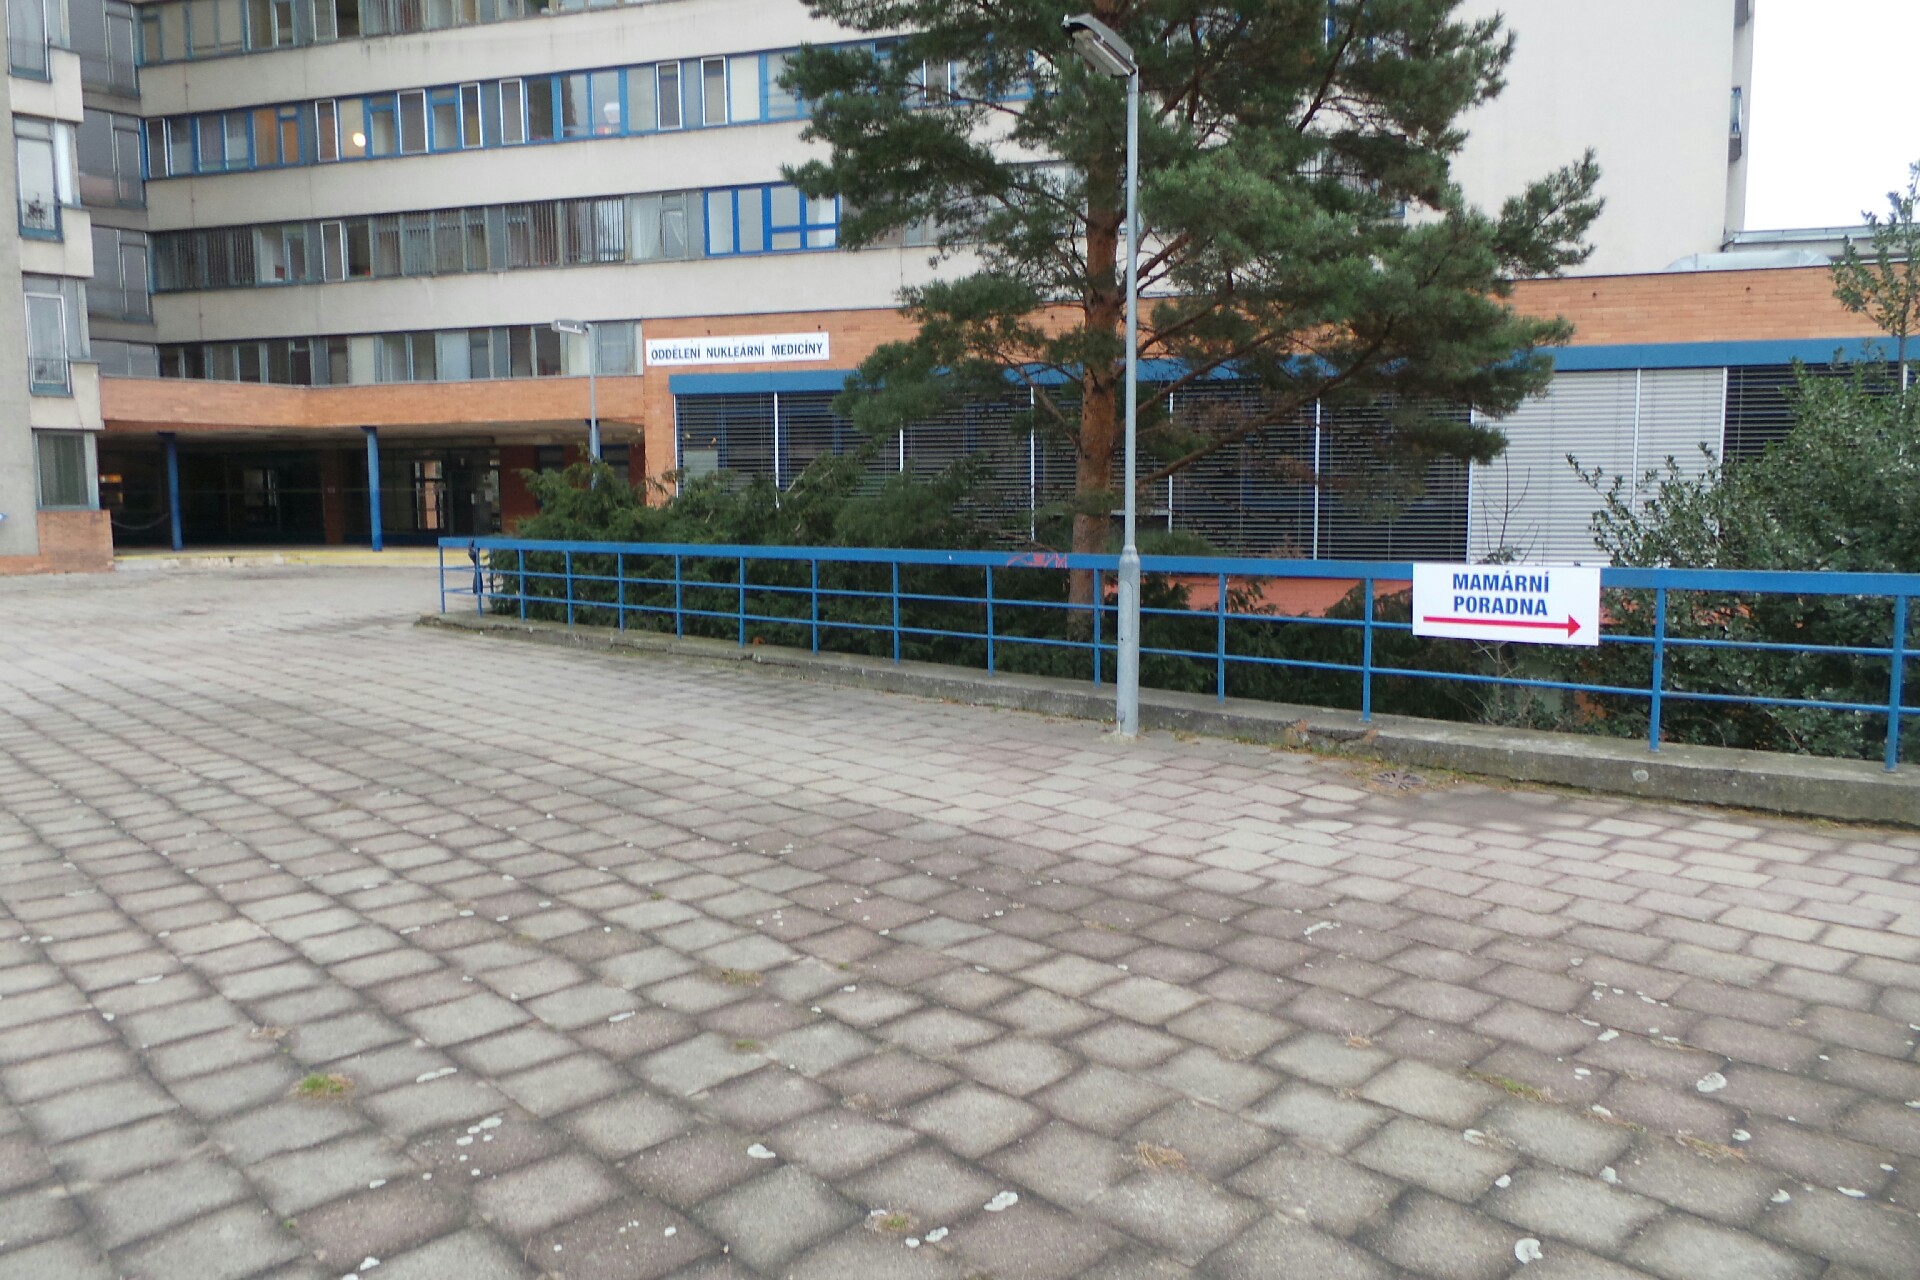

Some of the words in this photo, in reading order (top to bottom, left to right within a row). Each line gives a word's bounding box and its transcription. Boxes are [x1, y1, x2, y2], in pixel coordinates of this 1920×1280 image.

[651, 344, 701, 360] ODDĚLENÍ
[706, 342, 765, 358] NUKLEÁRNÍ
[771, 340, 823, 356] MEDICÍNY
[1452, 570, 1549, 592] MAMÁRNÍ
[1453, 596, 1548, 616] PORADNA
